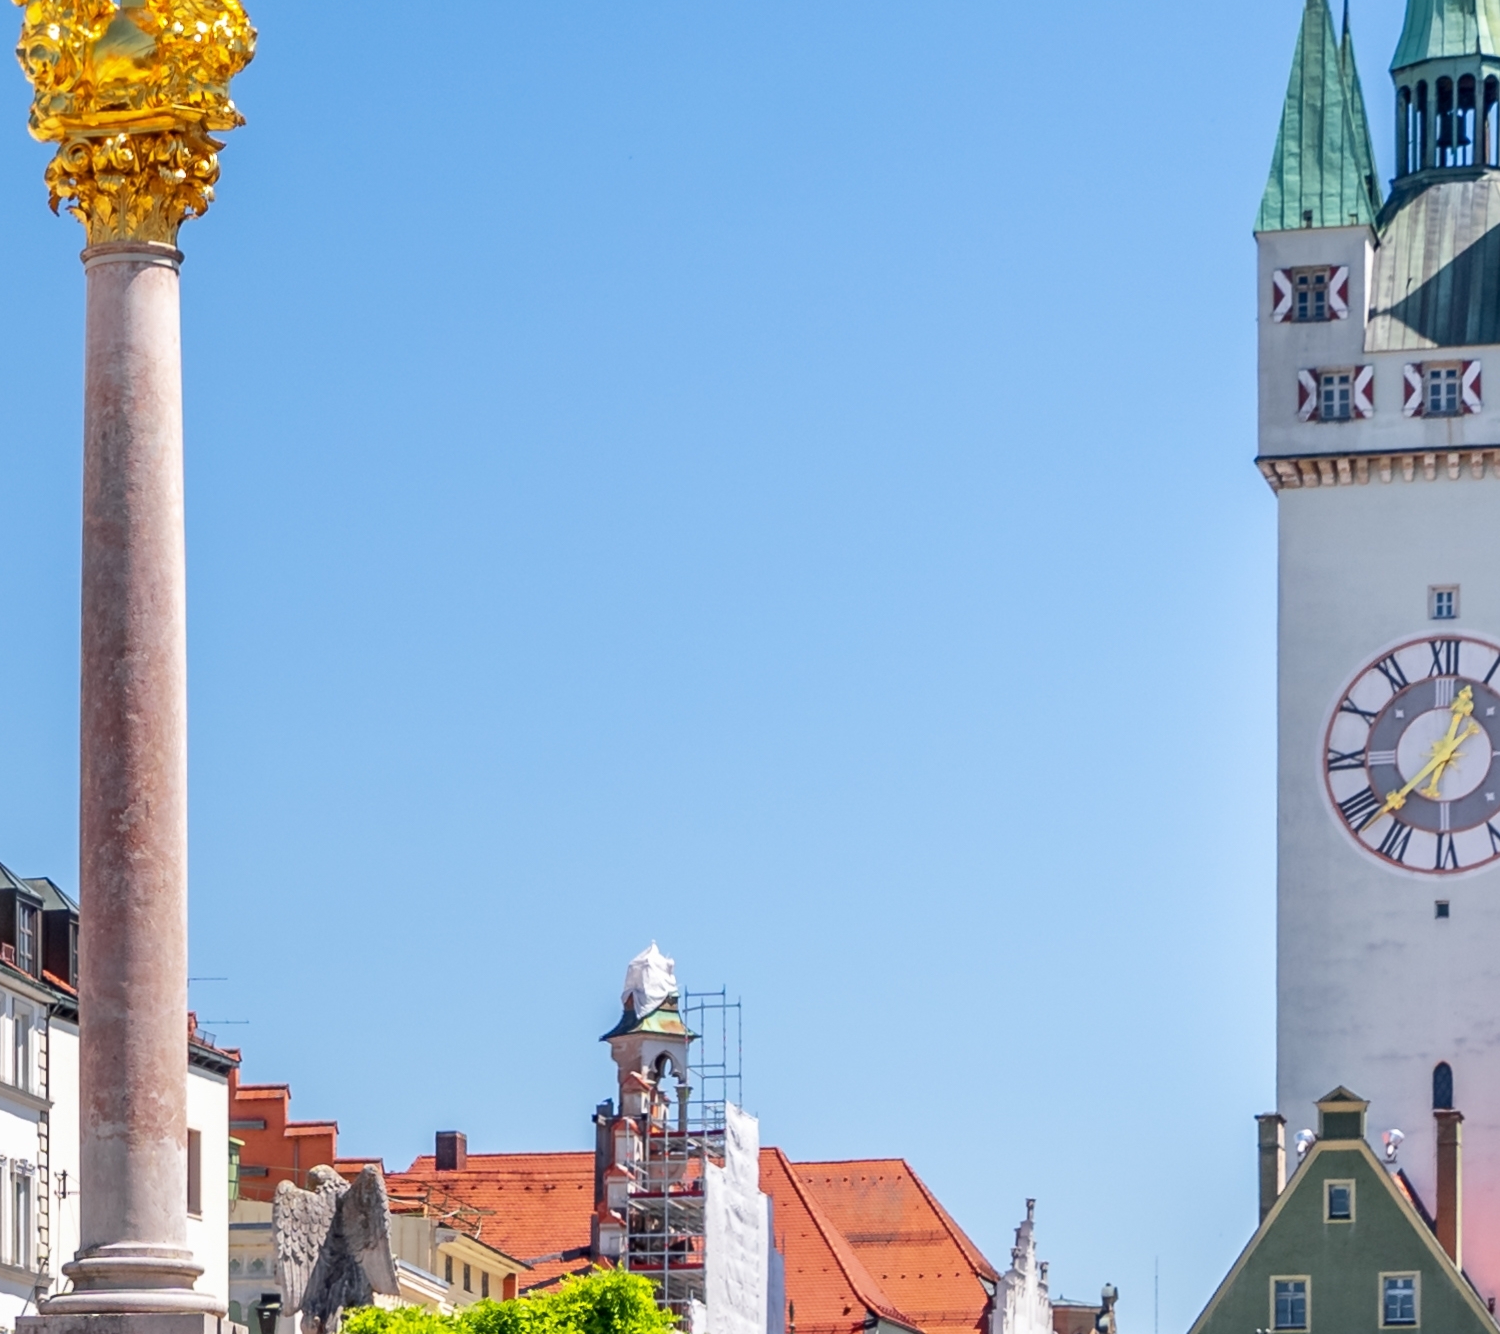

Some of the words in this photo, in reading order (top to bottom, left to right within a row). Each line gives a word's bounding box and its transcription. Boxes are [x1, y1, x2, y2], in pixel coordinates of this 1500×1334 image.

[1375, 653, 1410, 694] XI
[1428, 640, 1462, 677] XII
[1339, 696, 1379, 728] X
